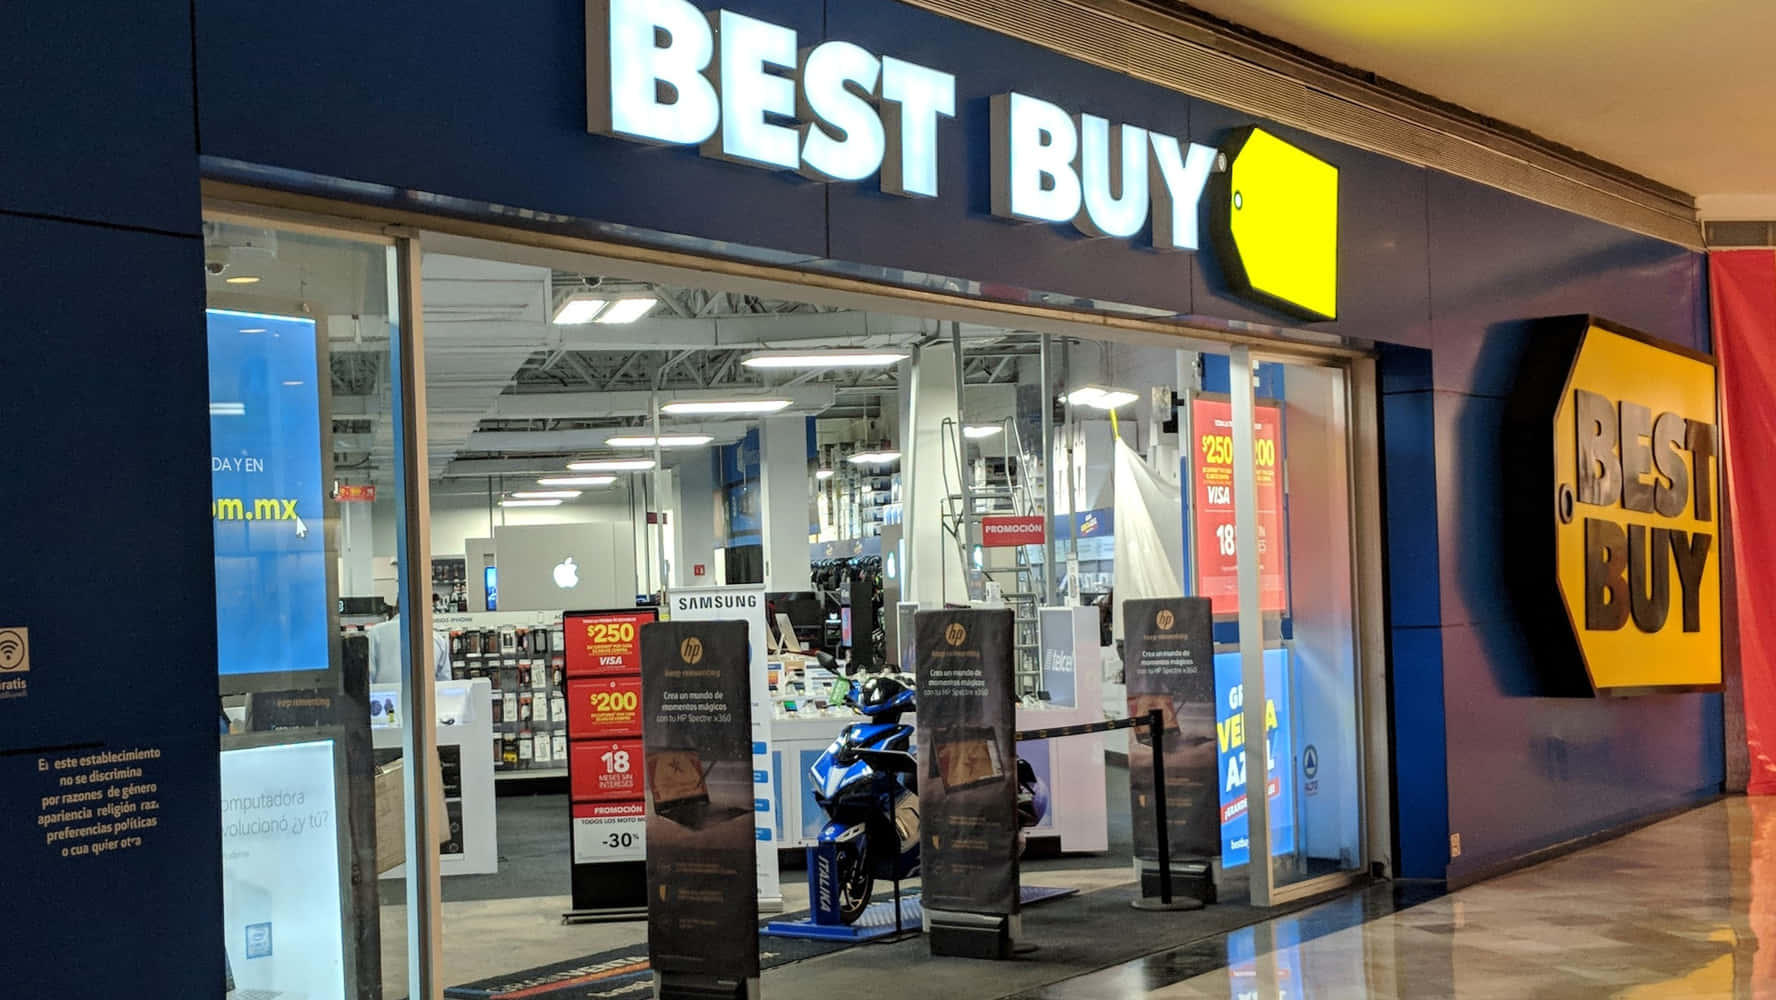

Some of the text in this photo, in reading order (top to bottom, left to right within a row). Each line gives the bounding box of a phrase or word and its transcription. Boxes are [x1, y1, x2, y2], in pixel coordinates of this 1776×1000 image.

[605, 0, 1219, 251] BEST BUY
[1202, 434, 1233, 464] $250
[1574, 388, 1718, 523] BEST
[245, 458, 264, 472] EN
[1207, 485, 1231, 505] VISA
[212, 497, 298, 520] m.mx
[985, 521, 1042, 534] PROMOCIÓN
[1216, 524, 1235, 556] 18
[1584, 517, 1713, 634] BUY
[679, 595, 757, 610] SAMSUNG
[587, 622, 634, 643] $250
[599, 656, 623, 666] VISA
[681, 637, 703, 665] hp
[590, 691, 637, 711] $200
[663, 690, 678, 700] Crea
[1216, 698, 1279, 753] VEA
[54, 757, 78, 770] este
[79, 747, 161, 767] establecimiento
[600, 750, 631, 773] 18
[1225, 738, 1276, 793] AZL
[59, 766, 143, 787] no se discrimina
[41, 782, 157, 810] por razones de género
[37, 807, 93, 828] apariencia
[97, 801, 137, 818] religión
[594, 804, 643, 815] PROMOCIÓN
[46, 822, 113, 844] preferencias
[61, 847, 69, 857] o
[817, 855, 832, 913] ITALIKA
